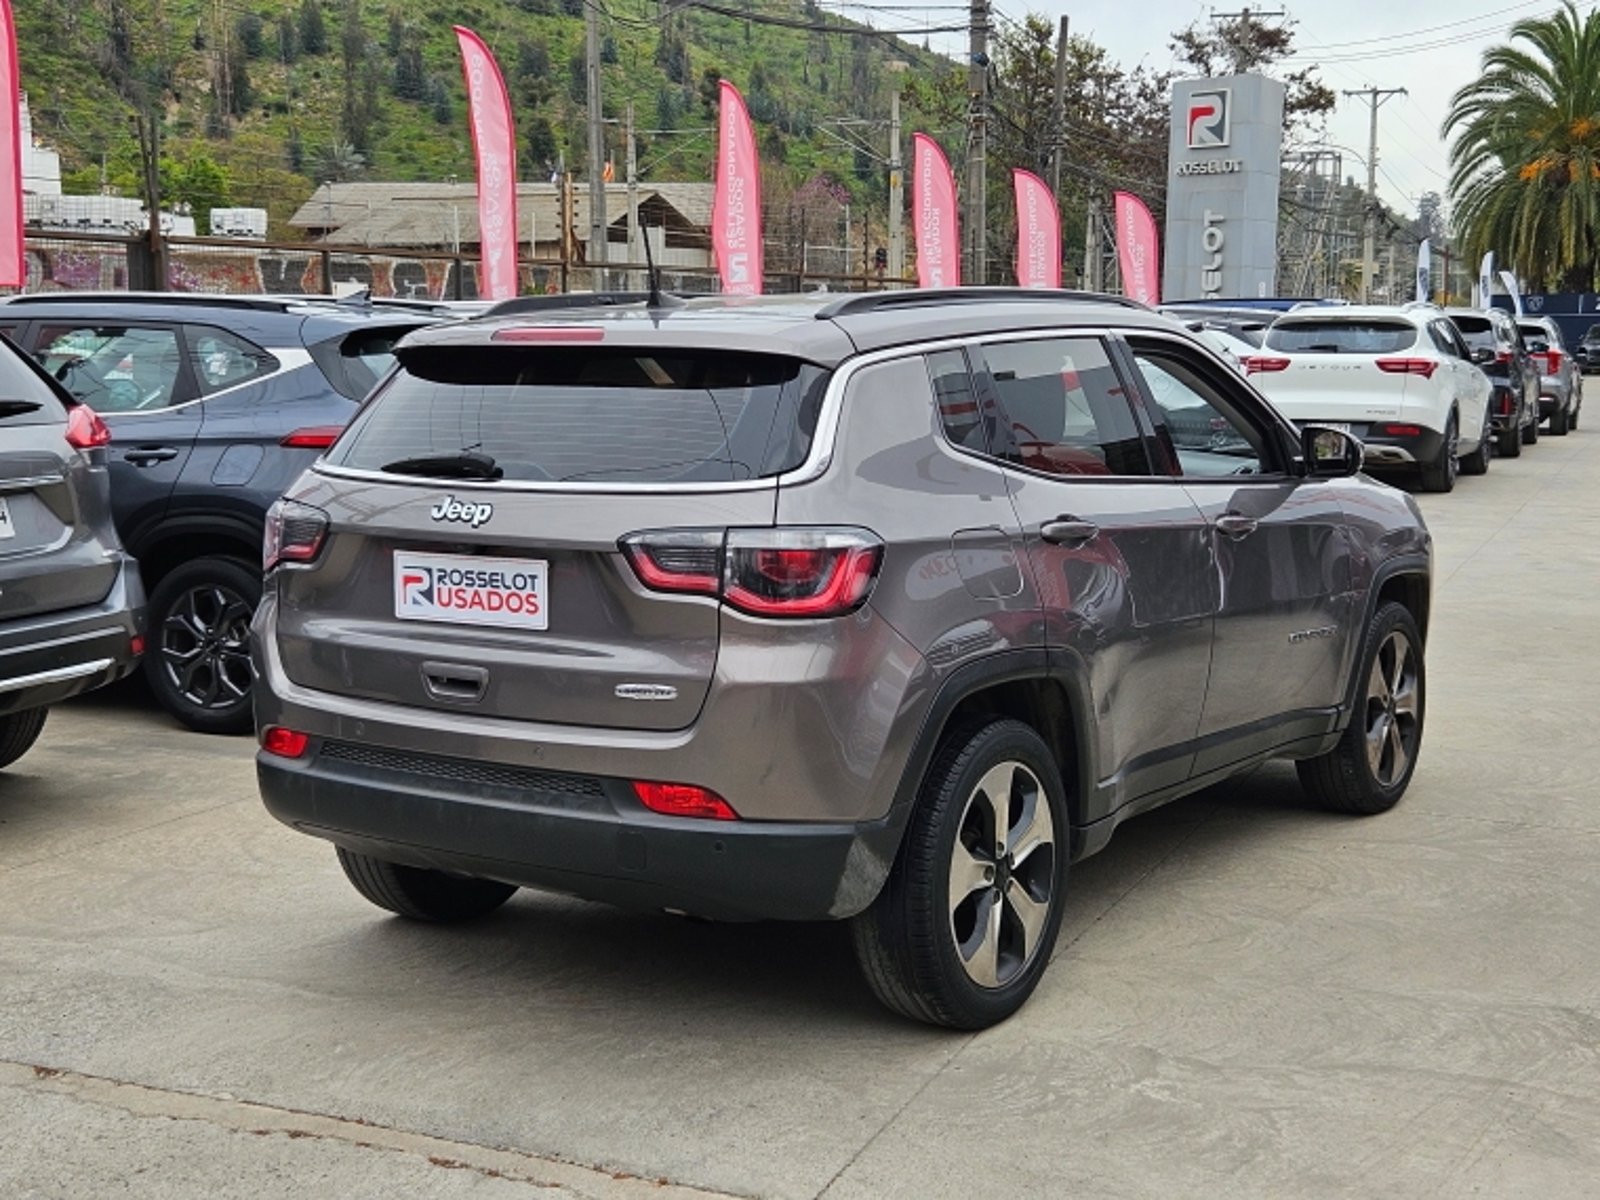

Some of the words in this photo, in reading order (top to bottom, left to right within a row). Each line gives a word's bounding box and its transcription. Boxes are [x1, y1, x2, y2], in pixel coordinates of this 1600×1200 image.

[1176, 159, 1241, 175] ROSSELOT
[430, 496, 493, 527] Jeep
[437, 567, 539, 592] ROSSELOT
[437, 588, 539, 615] USADOS
